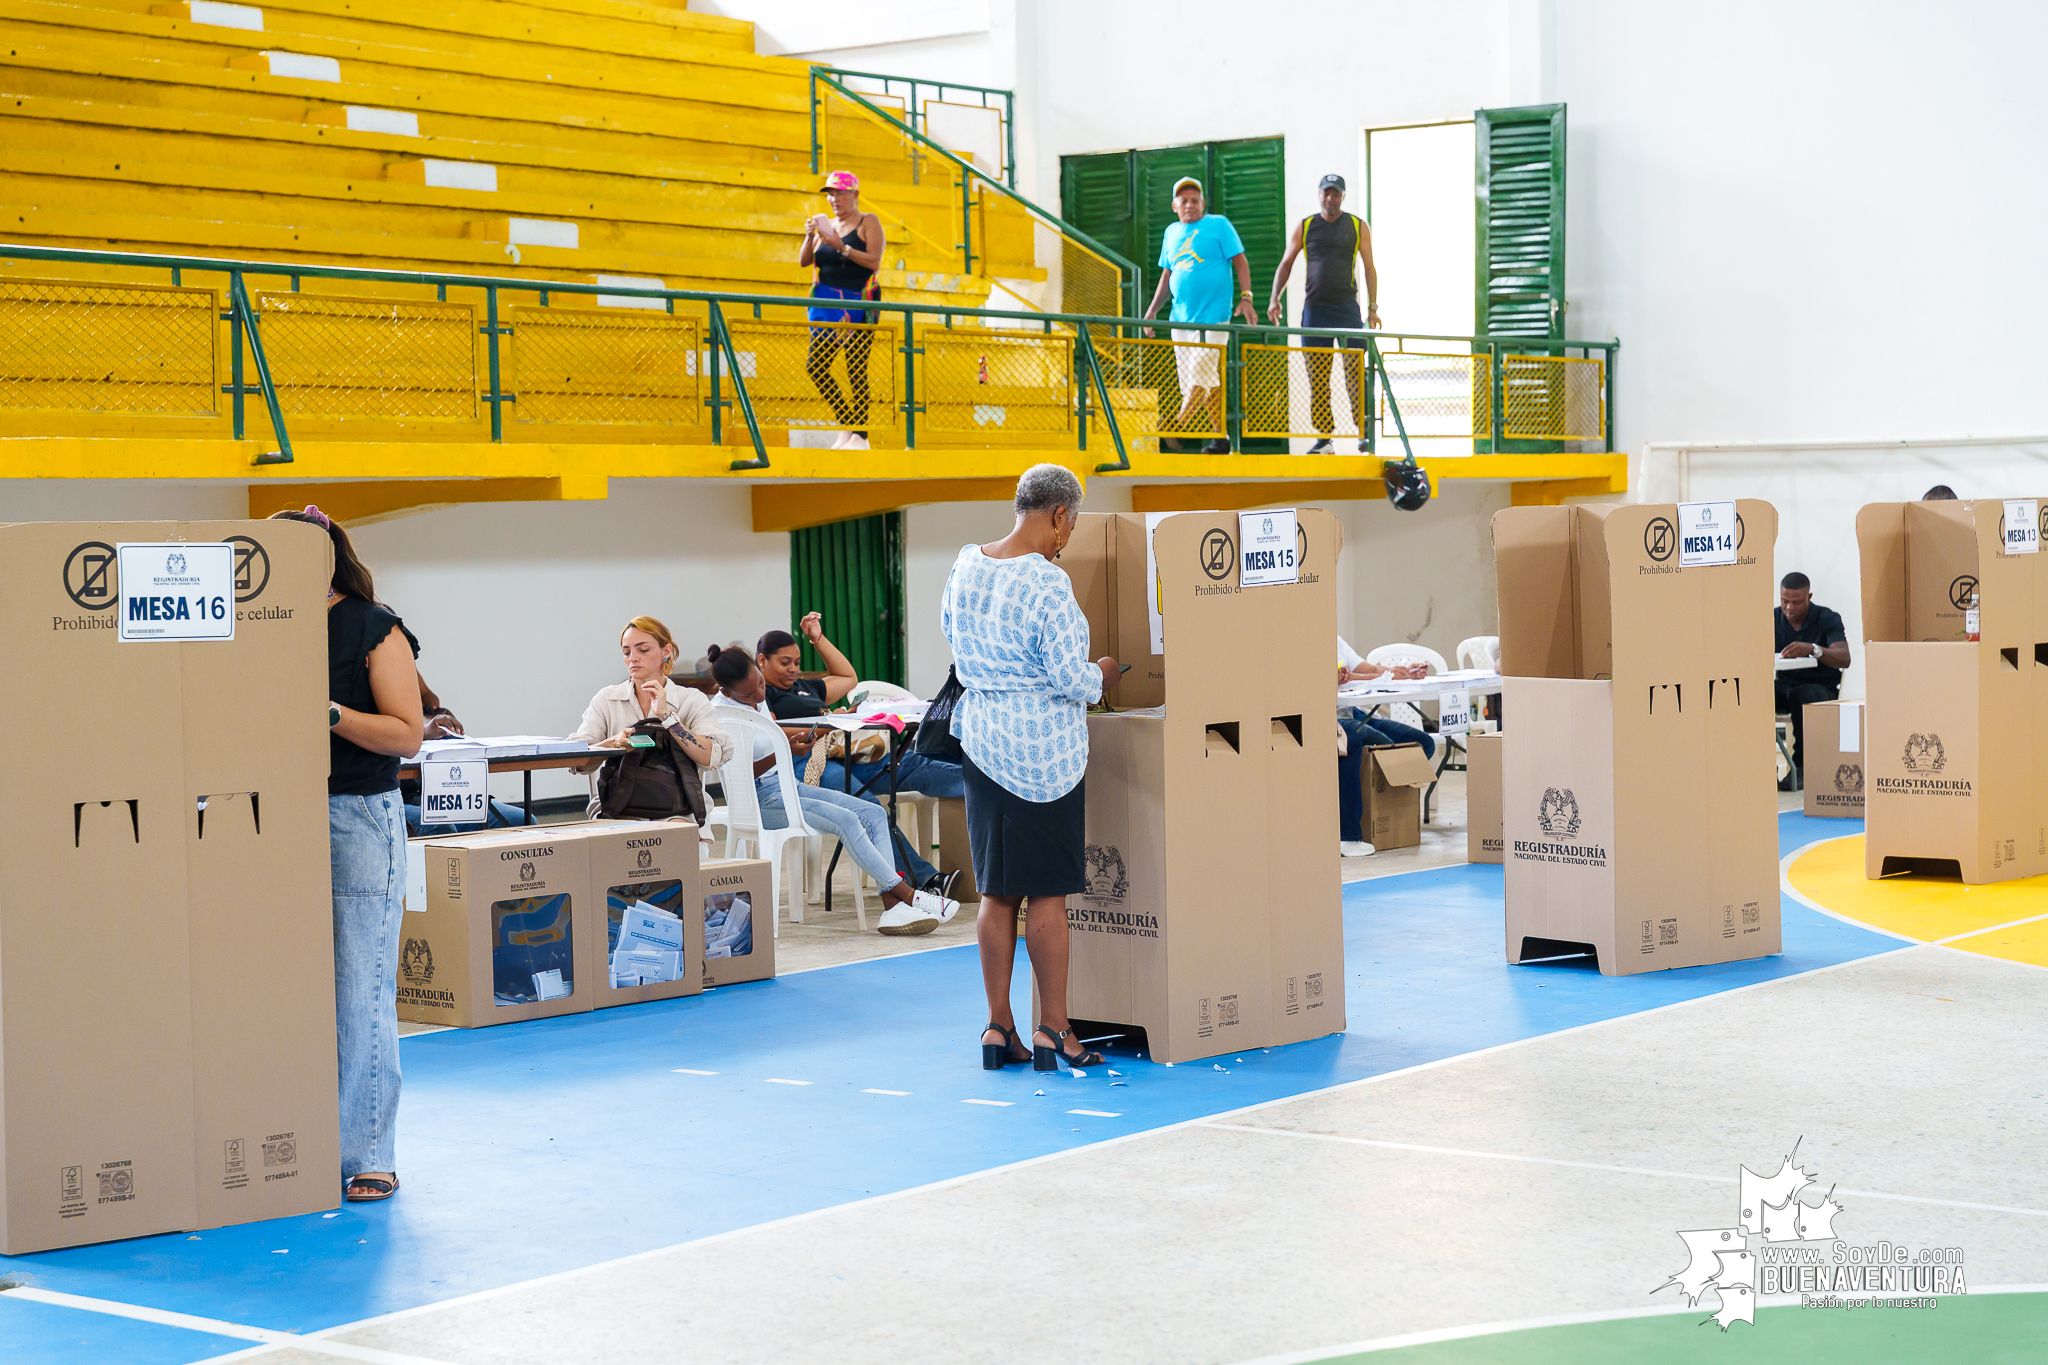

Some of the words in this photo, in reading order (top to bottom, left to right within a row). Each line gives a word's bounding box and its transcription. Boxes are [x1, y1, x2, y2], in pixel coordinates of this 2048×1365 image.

[2008, 529, 2026, 542] MESA
[2027, 528, 2036, 542] 13
[1684, 536, 1714, 554] MESA
[1716, 534, 1732, 550] 14
[1246, 550, 1276, 571] MESA
[1278, 549, 1294, 568] 15
[1639, 564, 1674, 576] Prohibido
[1736, 555, 1757, 565] elular
[1195, 583, 1234, 596] Prohibido
[1298, 572, 1320, 584] elular
[129, 596, 190, 620] MESA
[196, 596, 226, 620] 16
[234, 609, 243, 621] e
[247, 606, 294, 620] celular
[1442, 714, 1458, 726] MESA
[1460, 712, 1468, 724] 13
[1876, 778, 1972, 790] REGISTRADURÍA
[1876, 787, 1910, 795] NACIONAL
[427, 794, 462, 811] MESA
[466, 794, 483, 810] 15
[1816, 794, 1865, 802] REGISTRAD
[626, 837, 662, 850] SENADO
[1514, 840, 1606, 859] REGISTRADURÍA
[500, 846, 554, 861] CONSULTAS
[1514, 853, 1546, 862] NACIONAL
[1548, 855, 1561, 863] DEL
[1562, 856, 1588, 866] ESTADO
[1590, 859, 1606, 867] CIVIL
[710, 875, 744, 887] CÁMARA
[1066, 908, 1158, 929] GISTRADURÍA
[1088, 924, 1104, 932] DEL
[1106, 926, 1137, 935] ESTADO
[1139, 929, 1159, 938] CIVIL
[397, 987, 455, 1001] GISTRADURÍA
[421, 1000, 441, 1008] ESTADO
